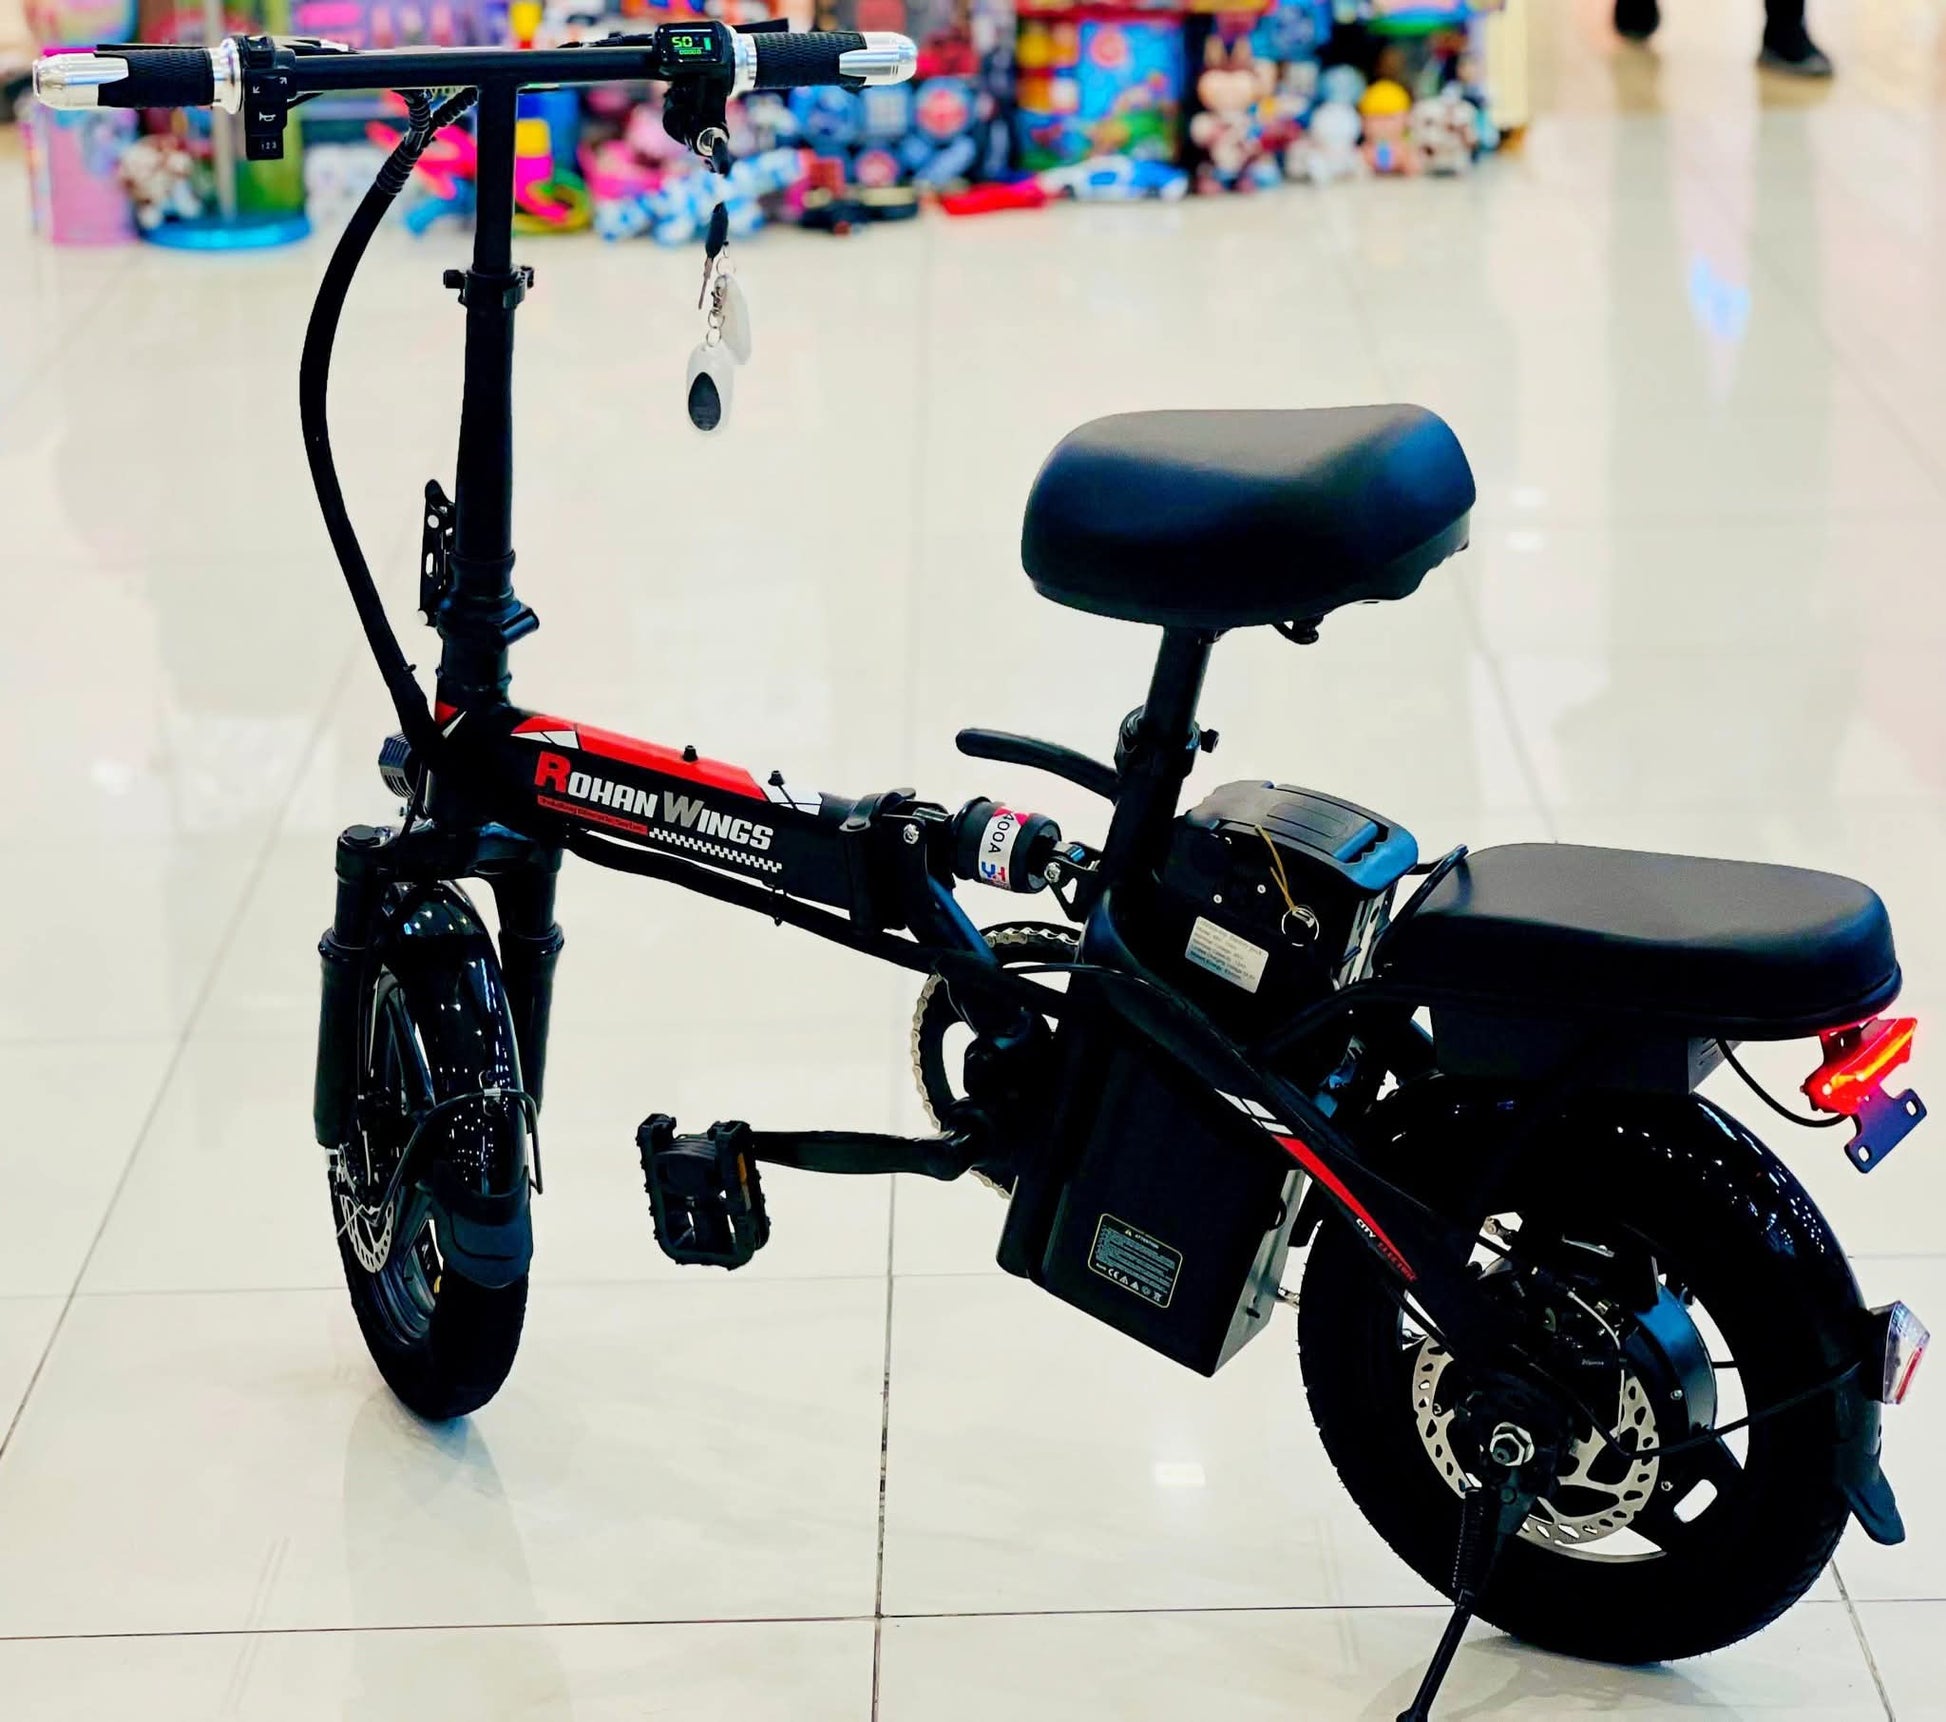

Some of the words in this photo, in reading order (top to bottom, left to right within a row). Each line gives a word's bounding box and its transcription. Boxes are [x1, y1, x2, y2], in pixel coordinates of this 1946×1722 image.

[534, 751, 657, 817] ROHAN
[663, 791, 773, 850] WINGS
[1356, 1218, 1376, 1238] CITY
